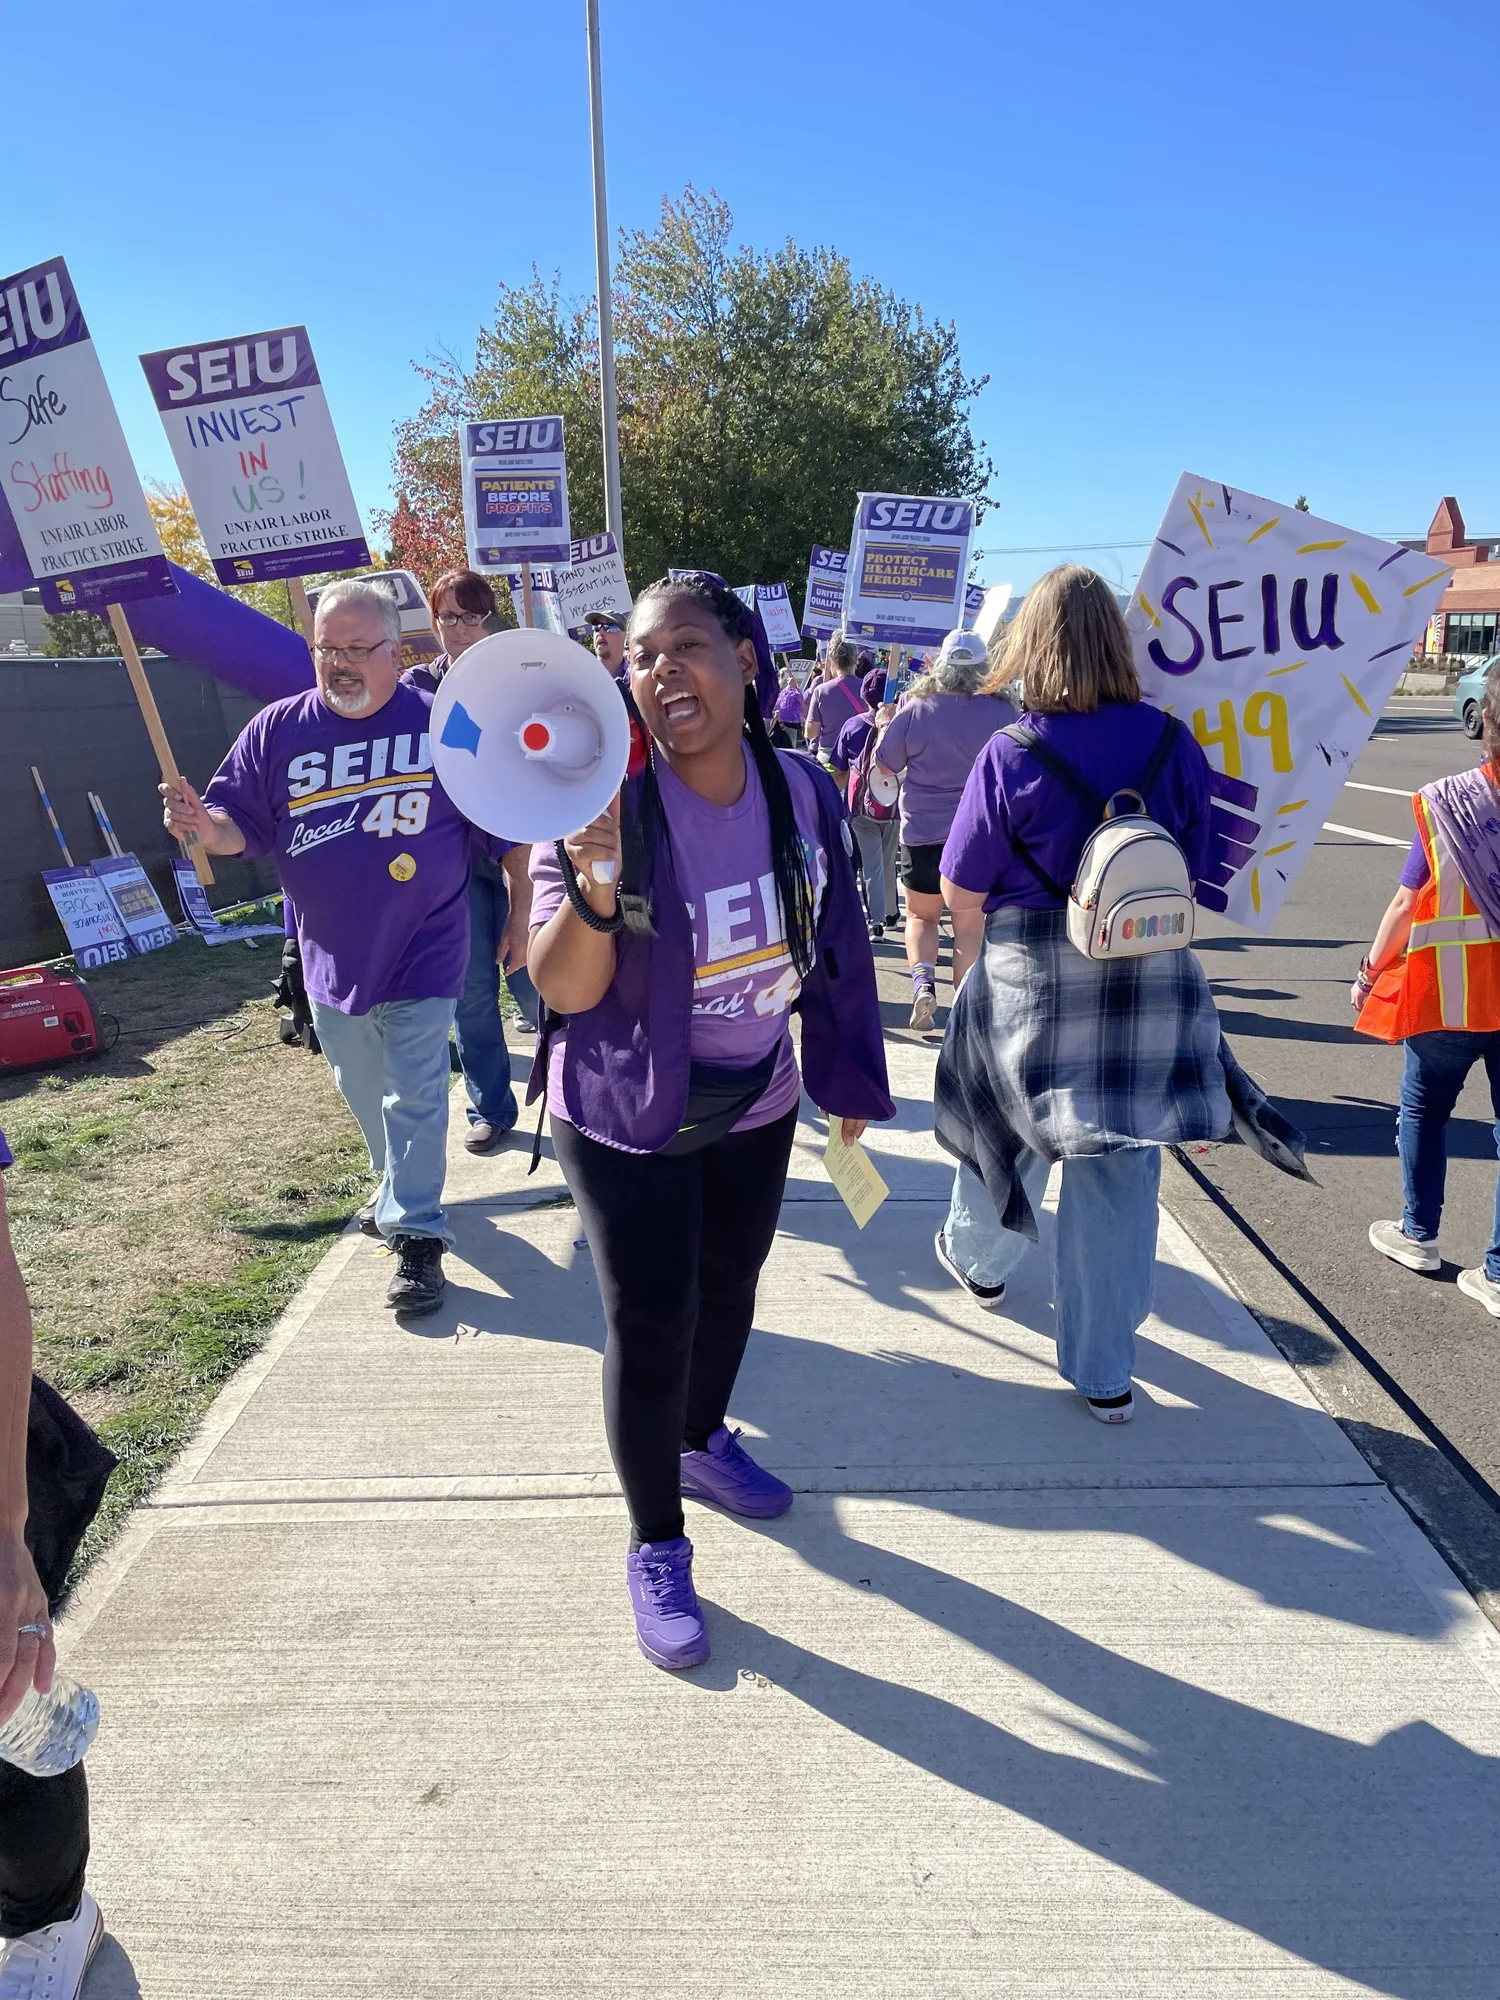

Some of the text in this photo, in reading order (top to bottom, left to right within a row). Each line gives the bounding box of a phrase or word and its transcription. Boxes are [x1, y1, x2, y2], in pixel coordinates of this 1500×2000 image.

[166, 335, 298, 401] SEIU
[0, 374, 67, 444] Safe
[185, 394, 306, 448] INVEST
[476, 422, 555, 452] SEIU
[239, 442, 269, 478] IN
[11, 452, 113, 512] Staffing
[482, 480, 555, 491] PATIENTS
[486, 503, 552, 514] PROFITS
[487, 492, 550, 502] BEFORE
[40, 512, 129, 547] UNFAIR LABOR
[224, 508, 332, 536] UNFAIR LABOR
[870, 501, 964, 530] SEIU
[220, 524, 349, 555] PRACTICE STRIKE
[571, 535, 608, 561] EIU
[41, 537, 148, 572] PRACTICE STRIKE
[589, 559, 617, 574] WITH
[866, 553, 928, 566] PROTECT
[863, 574, 922, 587] HEROES!
[865, 563, 955, 579] HEALTHCARE
[558, 574, 622, 602] ESSENTIAL
[757, 585, 782, 599] SEIU
[569, 596, 616, 619] WORKERS
[1147, 573, 1345, 677] SEIU
[1193, 690, 1294, 780] 49
[287, 733, 434, 798] SEIU
[286, 791, 431, 854] Local 49
[1122, 912, 1185, 939] COACH
[83, 941, 127, 968] SEIU
[133, 927, 172, 954] SEIU
[11, 999, 41, 1009] HONDA
